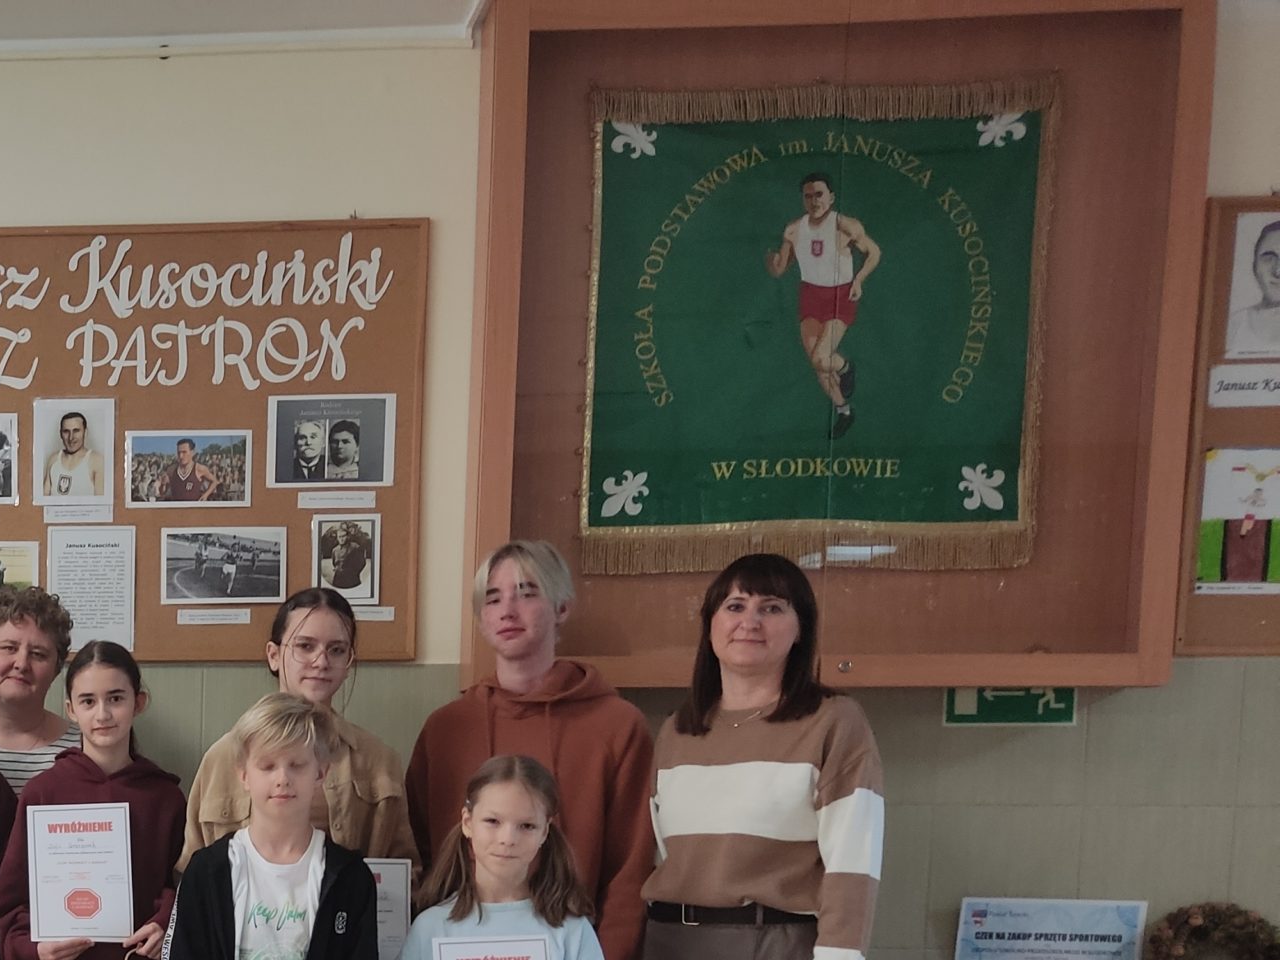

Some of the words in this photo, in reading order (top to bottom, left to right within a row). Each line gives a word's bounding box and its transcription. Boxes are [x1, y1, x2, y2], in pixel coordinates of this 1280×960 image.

[823, 131, 934, 189] JANUSZA
[638, 145, 768, 291] PODSTAWOWA
[59, 231, 395, 319] Kusociński
[938, 187, 997, 404] KUSOCIŃSKIEGO
[66, 315, 365, 391] PATRON
[635, 303, 674, 408] SZKOŁA
[1214, 380, 1259, 394] Janusz
[711, 461, 736, 480] W
[743, 457, 900, 479] SŁODKOWIE
[48, 821, 113, 834] WYRÓŻNIENIE
[248, 901, 278, 928] Keep
[995, 931, 1006, 940] NA
[1007, 932, 1031, 941] ZAKUP
[1069, 933, 1123, 943] SPORTOWEGO
